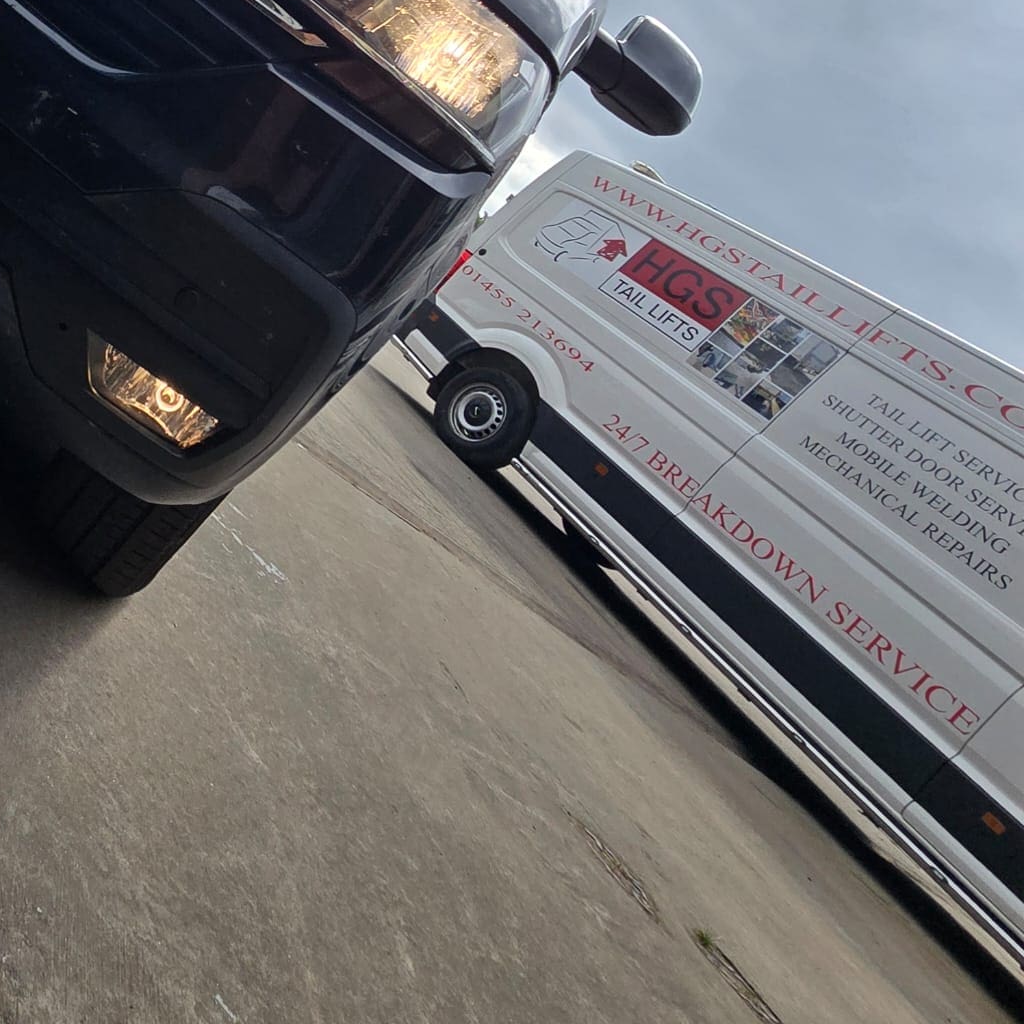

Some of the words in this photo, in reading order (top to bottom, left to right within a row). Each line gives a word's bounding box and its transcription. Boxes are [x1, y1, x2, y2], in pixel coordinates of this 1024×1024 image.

[462, 264, 517, 308] 01455
[516, 308, 595, 372] 213694
[612, 279, 644, 310] TAIL
[648, 304, 699, 341] LIFTS
[631, 248, 734, 320] HGS
[822, 394, 905, 453] SHUTTER
[904, 449, 966, 493] DOOR
[867, 393, 906, 425] TAIL
[907, 420, 956, 453] LIFT
[799, 435, 919, 527] MECHANICAL
[921, 522, 1014, 590] REPAIRS
[836, 432, 912, 487] MOBILE
[911, 481, 1012, 555] WELDING
[602, 414, 650, 453] 24/7
[646, 449, 829, 604] BREAKDOWN
[826, 601, 980, 736] SERVICE
